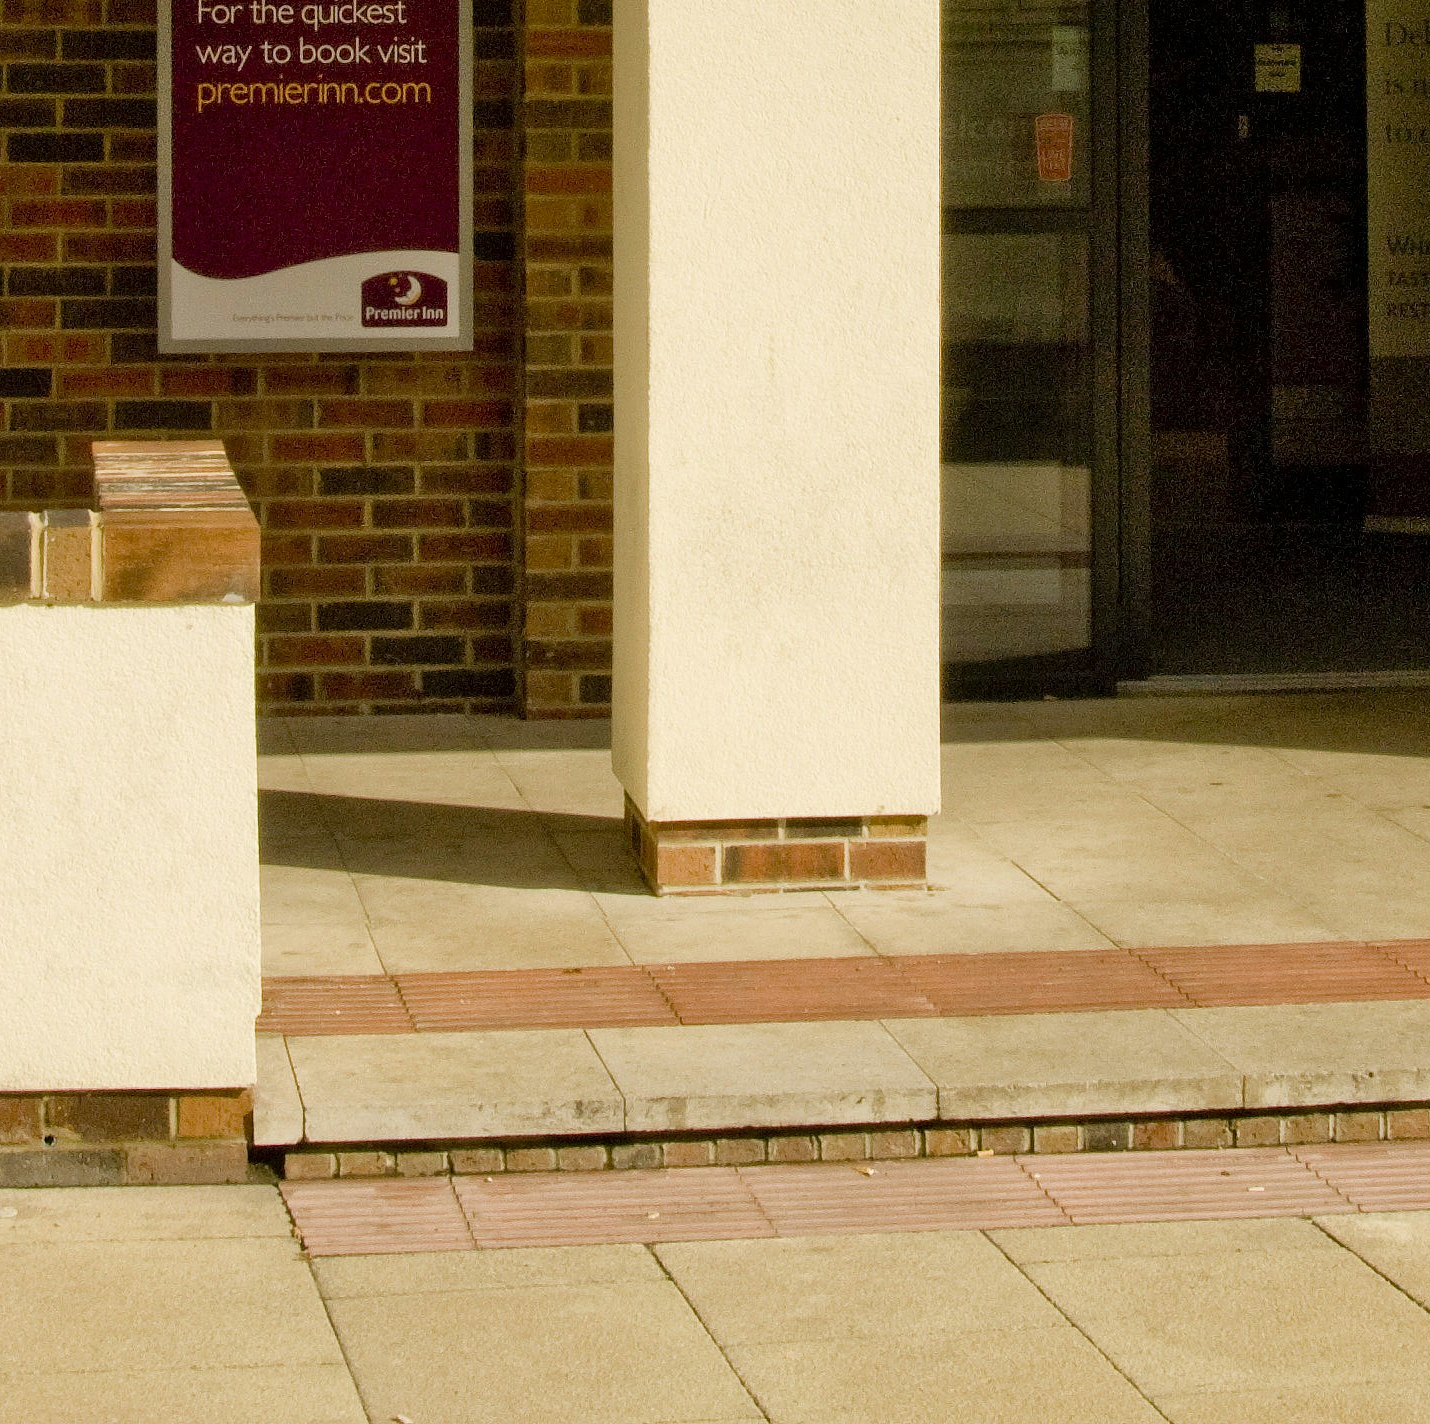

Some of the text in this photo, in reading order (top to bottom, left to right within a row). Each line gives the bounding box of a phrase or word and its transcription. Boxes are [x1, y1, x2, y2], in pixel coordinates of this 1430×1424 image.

[196, 36, 427, 71] way to book visit
[197, 75, 431, 113] premierinn.com
[1386, 70, 1404, 95] is
[1386, 122, 1411, 143] to
[366, 306, 444, 321] Premier Inn
